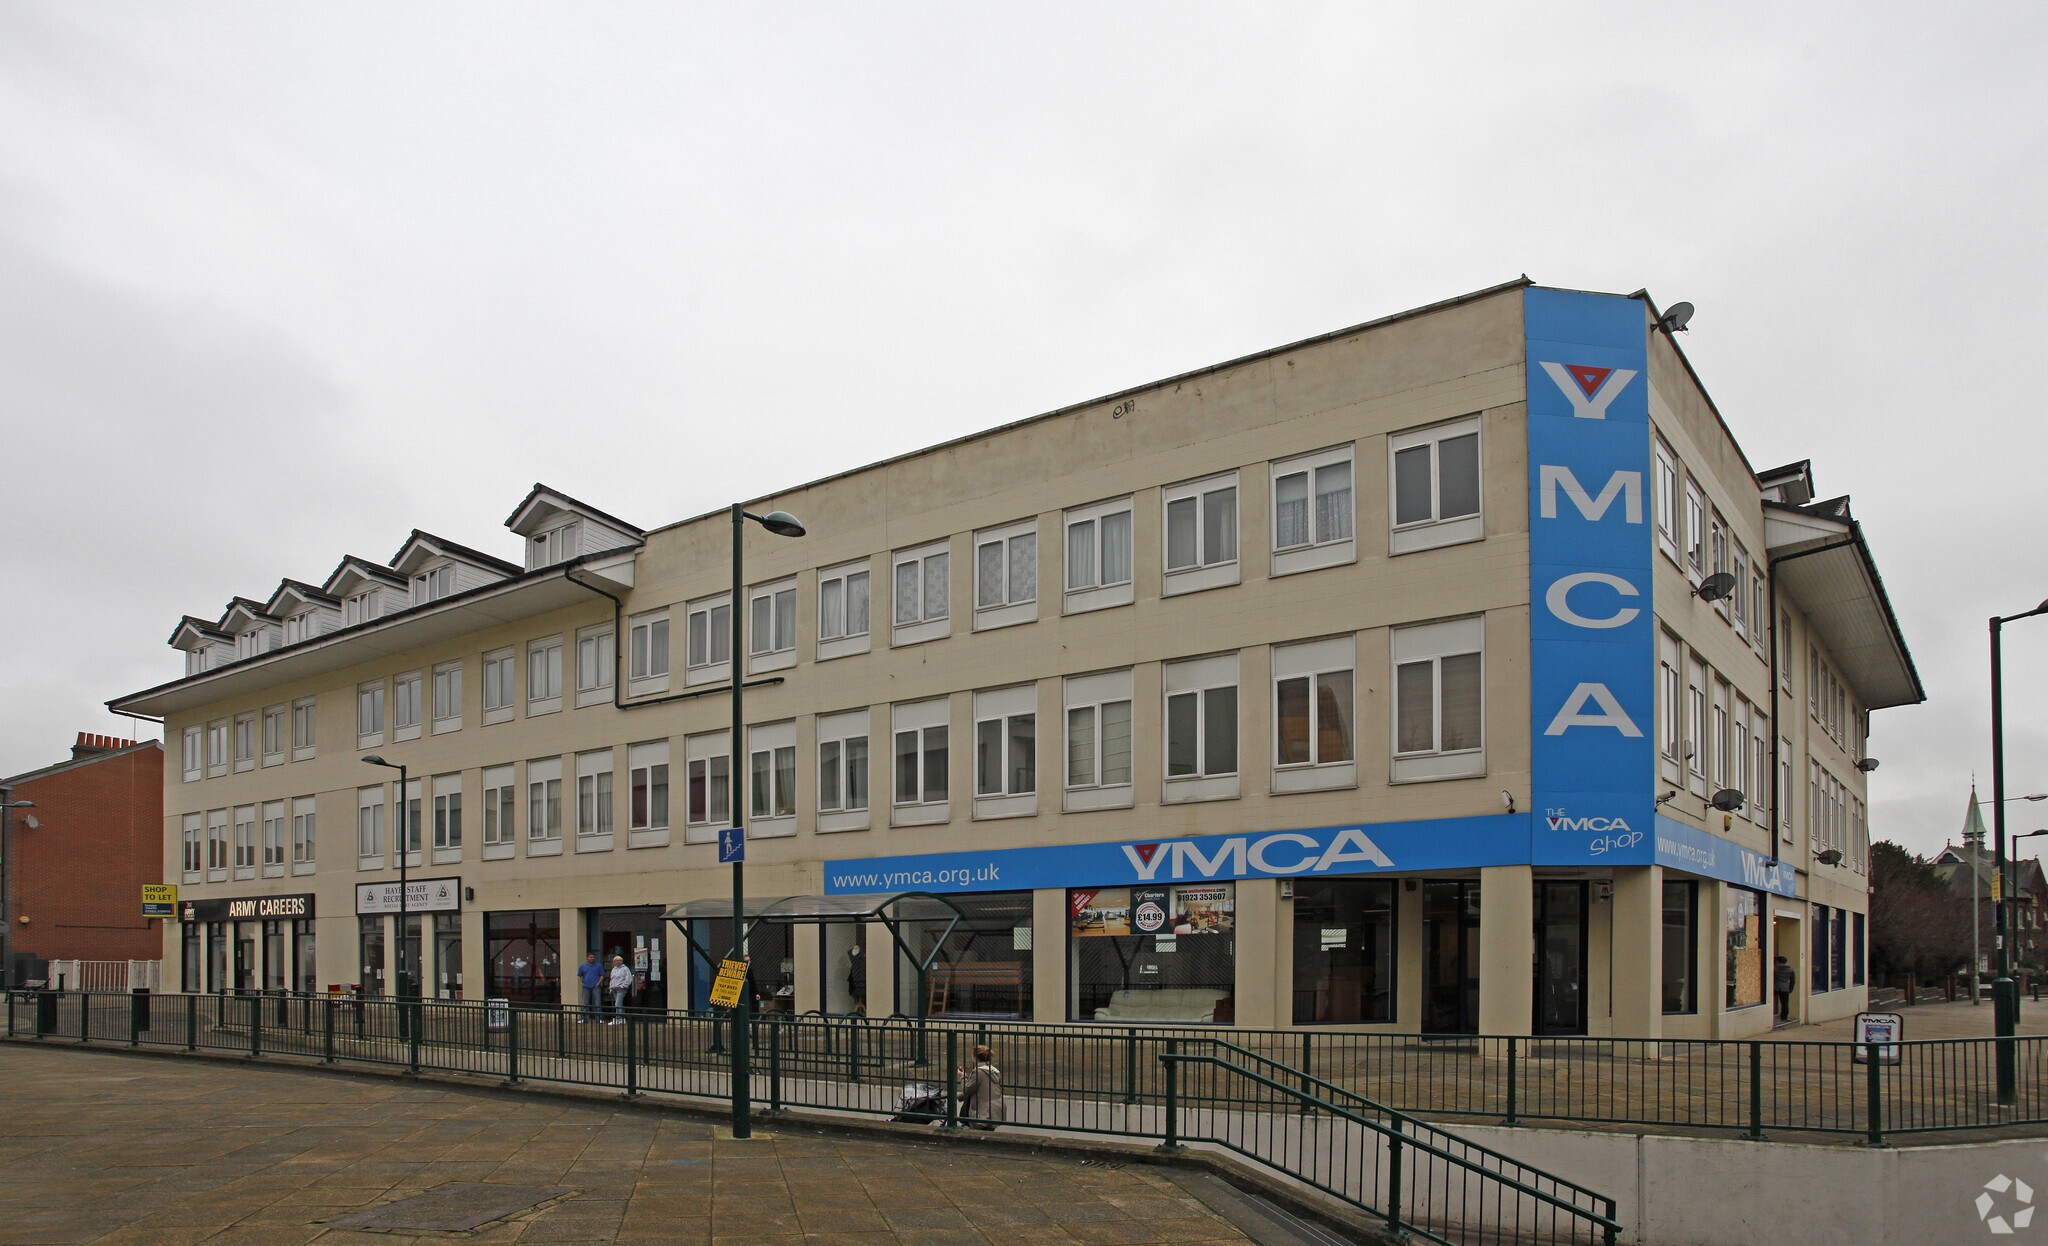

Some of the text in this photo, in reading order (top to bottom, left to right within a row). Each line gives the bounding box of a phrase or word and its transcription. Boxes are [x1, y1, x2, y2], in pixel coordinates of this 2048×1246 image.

[1538, 360, 1645, 738] YMCA
[1545, 808, 1566, 816] THE
[1545, 817, 1632, 832] YMCA
[1120, 829, 1395, 880] YMCA
[1657, 836, 1716, 868] www.ymca.org.uk
[832, 863, 1000, 889] www.ymca.org.uk
[407, 885, 426, 893] STAFF
[383, 894, 429, 903] RECRTMENT
[1177, 894, 1198, 902] 01923
[229, 898, 305, 917] ARMY CAREERS
[1138, 913, 1162, 921] £14.99
[722, 960, 747, 970] THIEVES
[719, 968, 745, 980] BEWARE
